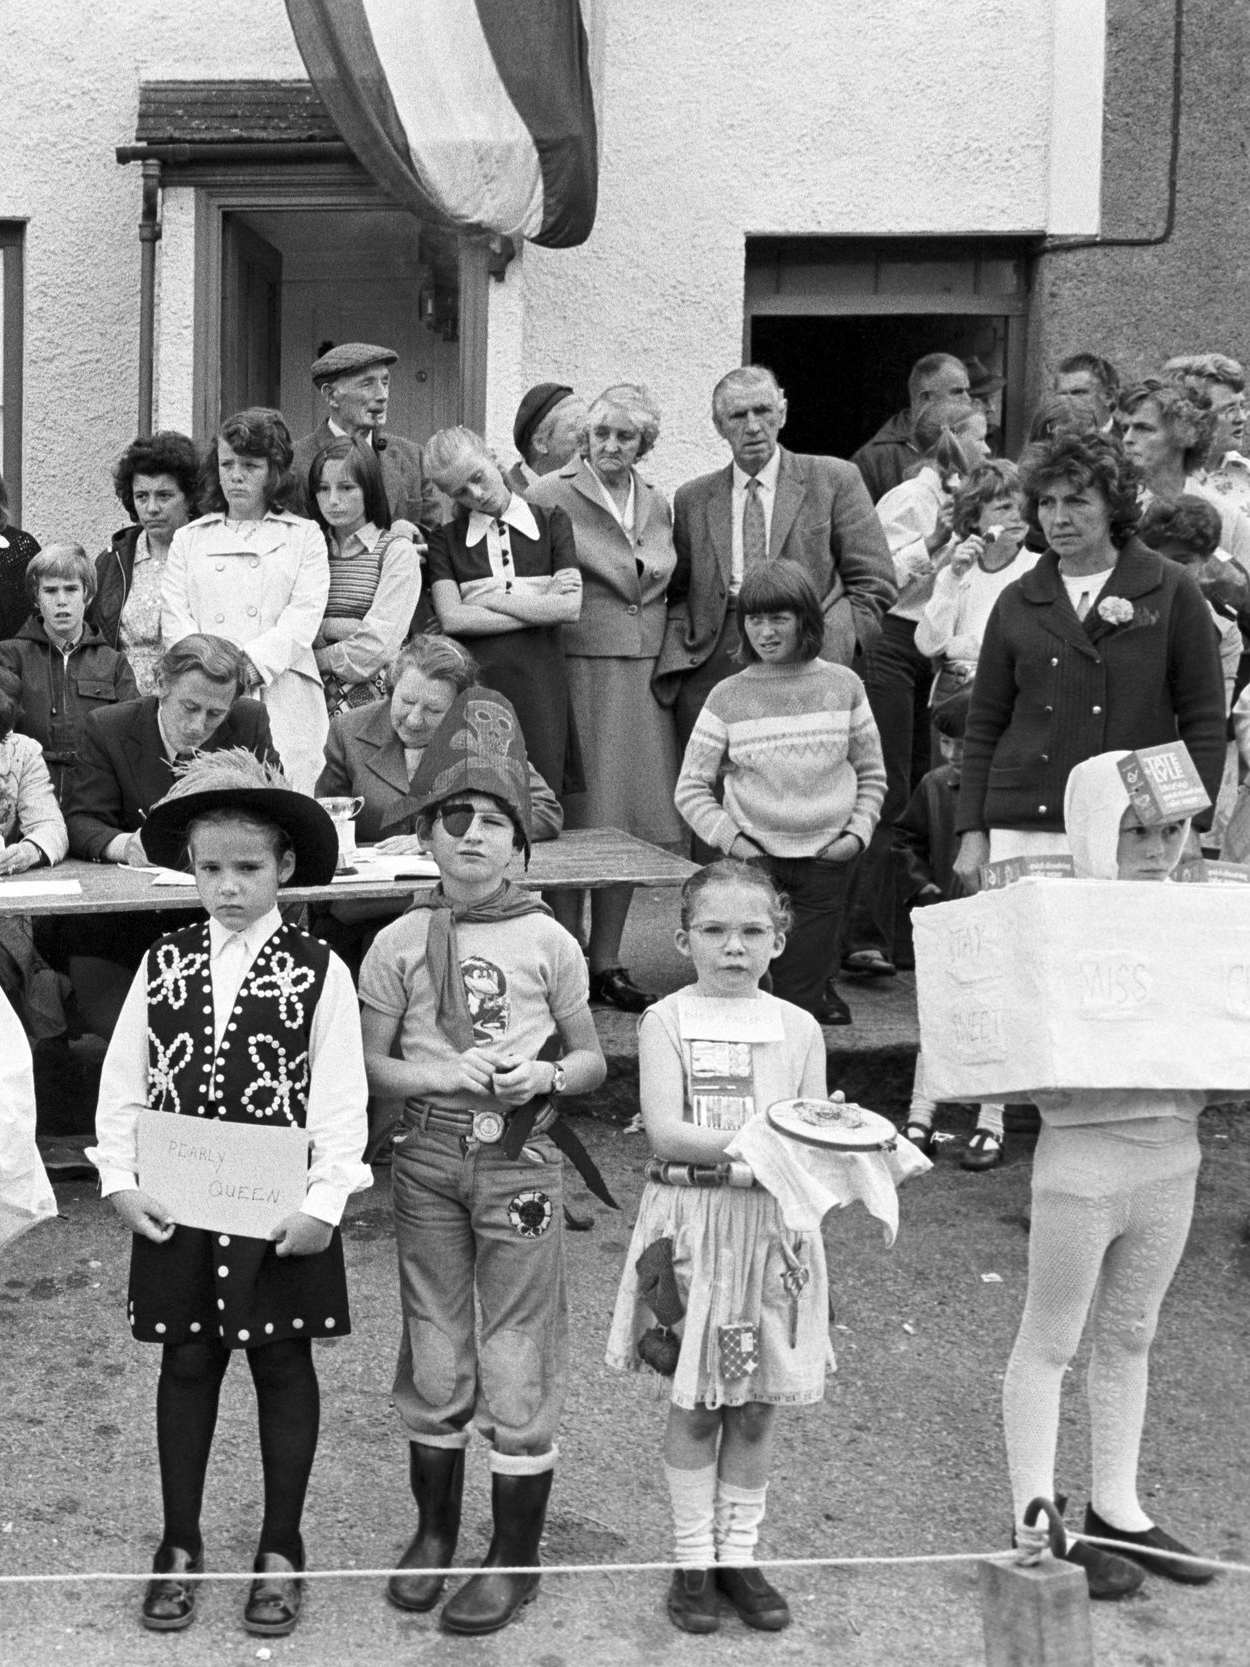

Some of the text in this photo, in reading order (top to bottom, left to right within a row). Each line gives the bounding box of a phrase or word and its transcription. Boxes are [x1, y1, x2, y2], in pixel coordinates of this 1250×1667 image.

[1143, 752, 1181, 770] TATE
[1152, 767, 1185, 783] LYLE
[1078, 962, 1148, 1005] MISS
[169, 1140, 225, 1174] PEARLY
[209, 1180, 280, 1204] QUEEN
